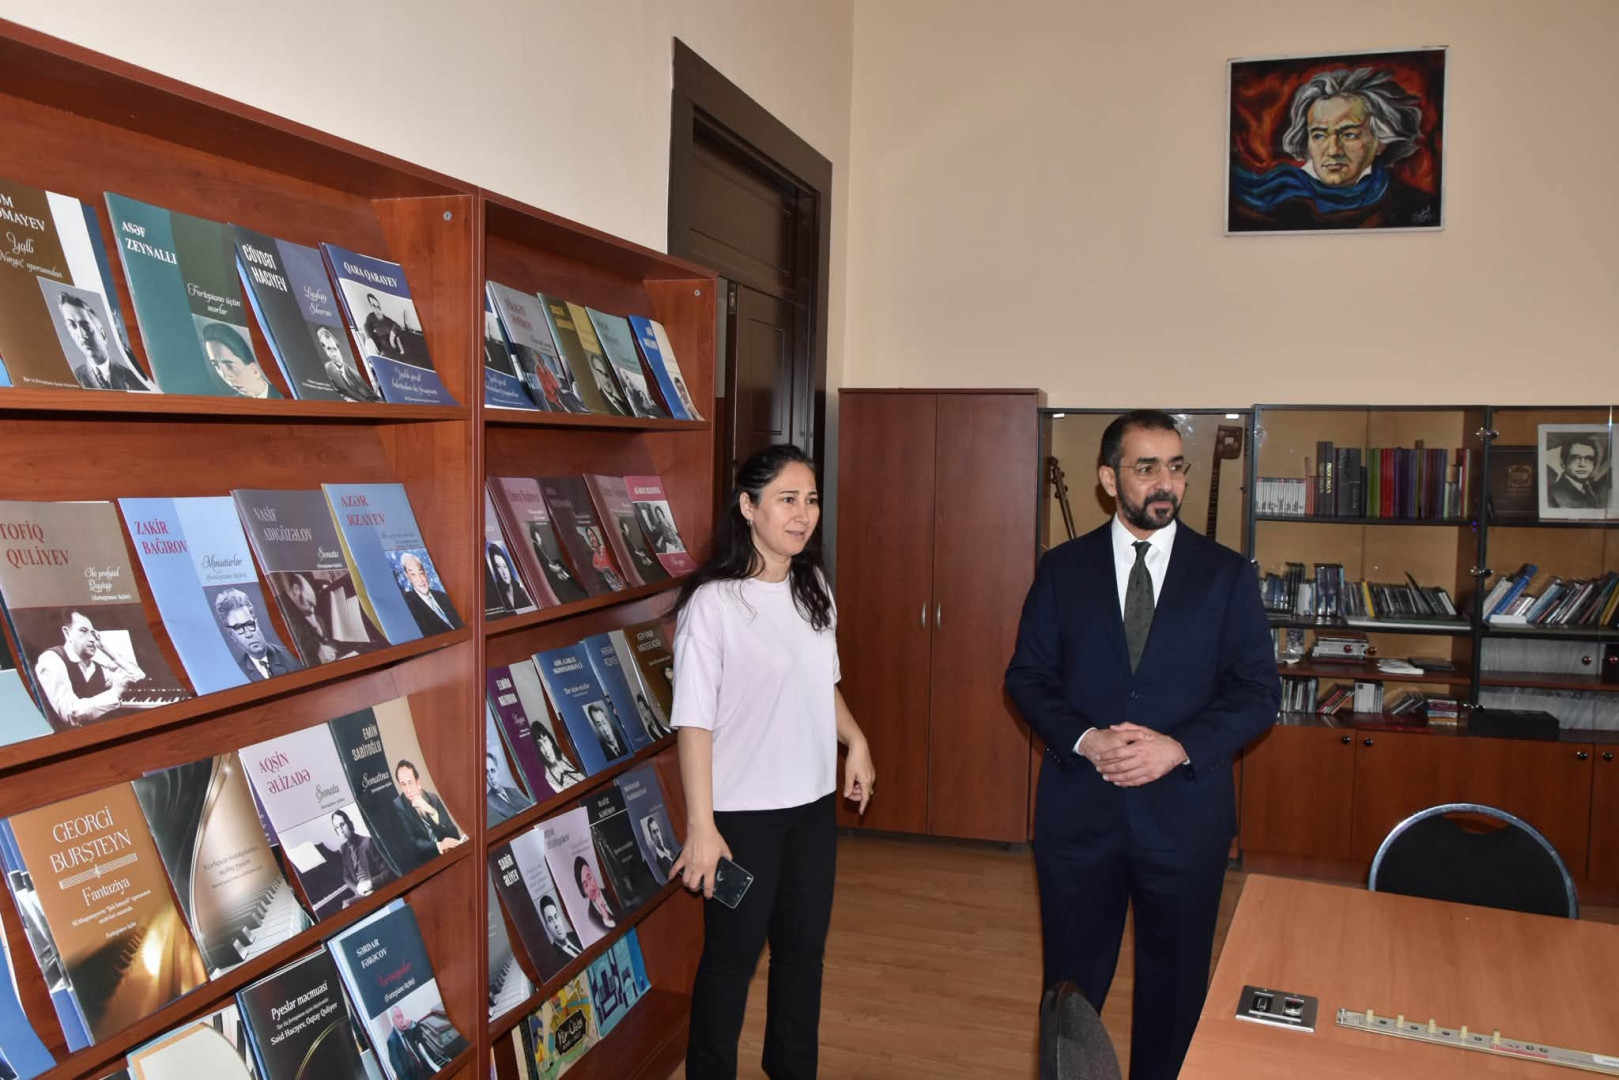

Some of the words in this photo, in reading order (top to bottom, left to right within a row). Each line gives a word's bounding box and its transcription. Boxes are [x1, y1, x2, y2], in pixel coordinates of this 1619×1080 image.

[122, 221, 146, 237] ASƏF
[125, 237, 178, 265] ZEYNALLI
[251, 266, 288, 292] HACIYEV
[343, 261, 365, 278] QARA
[363, 269, 397, 288] QARAYEV
[187, 282, 225, 303] Fortepiano
[253, 505, 277, 522] VASİF
[0, 520, 44, 542] TOFİQ
[134, 518, 169, 535] ZAKİR
[263, 524, 312, 542] ADIGÖZƏLOV
[7, 545, 70, 569] QULİYEV
[142, 538, 187, 555] BAĞIROV
[258, 751, 289, 774] AQŞİN
[266, 769, 311, 795] ƏLİZADƏ
[362, 771, 390, 792] Sonatina
[52, 806, 114, 844] GEORGİ
[50, 829, 132, 874] BURŞTEYN
[81, 877, 130, 907] Fantaziya
